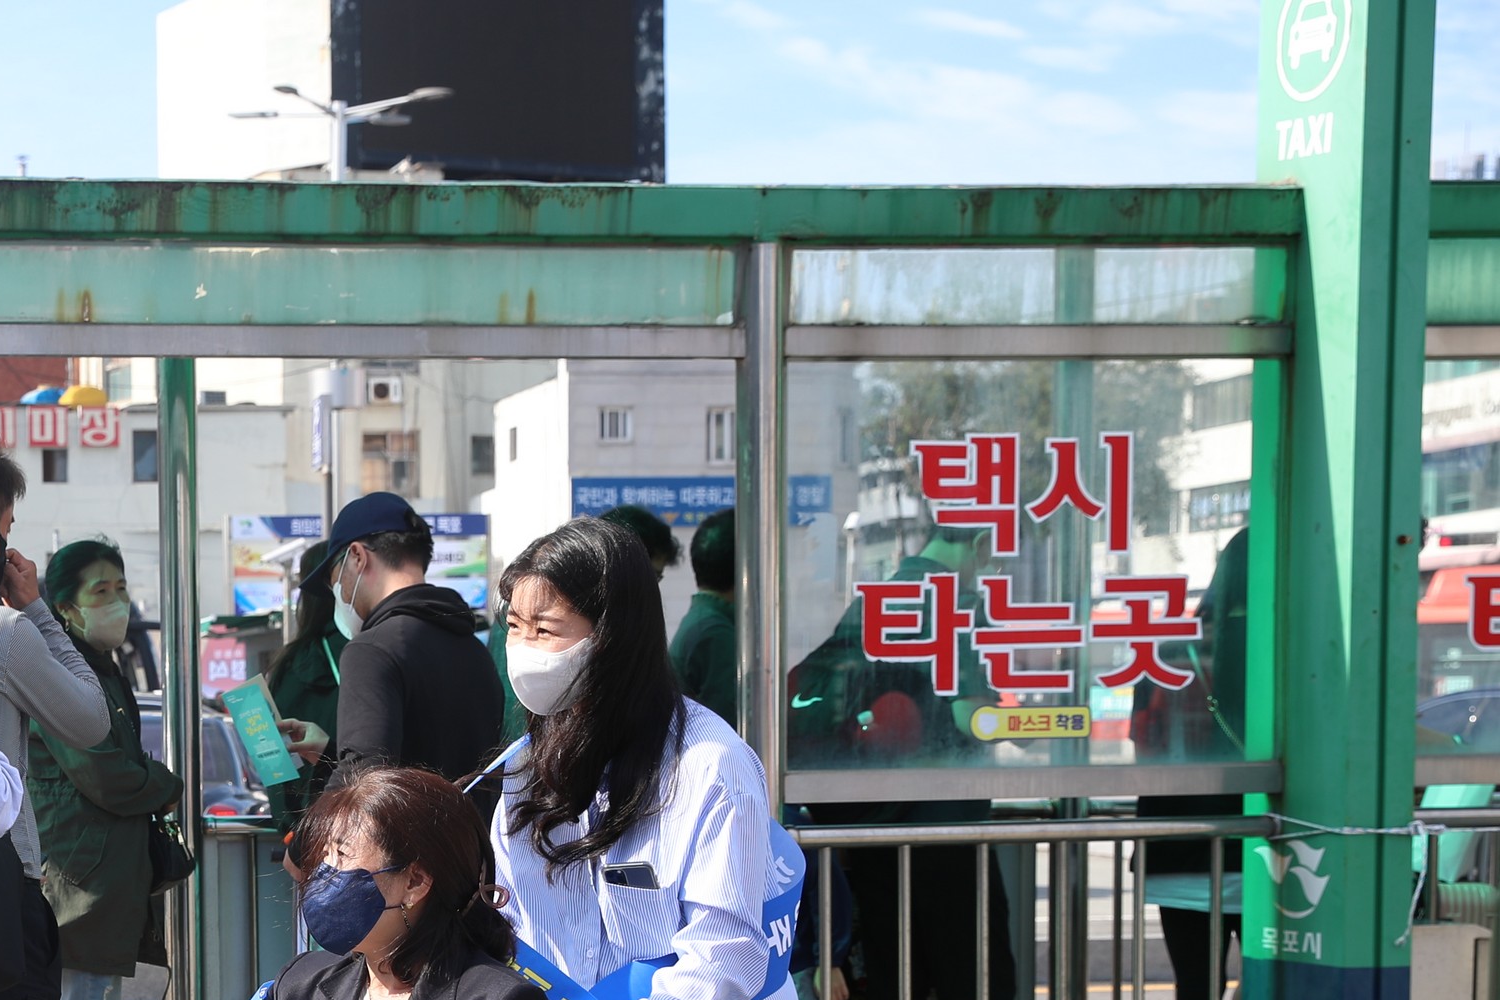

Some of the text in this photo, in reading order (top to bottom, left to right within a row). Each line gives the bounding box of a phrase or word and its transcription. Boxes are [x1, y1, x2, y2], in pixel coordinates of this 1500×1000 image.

[1275, 112, 1334, 162] TAXI
[910, 431, 1136, 557] 택시
[854, 572, 1203, 696] 타는곳
[1008, 714, 1051, 732] 마스크
[1261, 925, 1323, 960] 목포시
